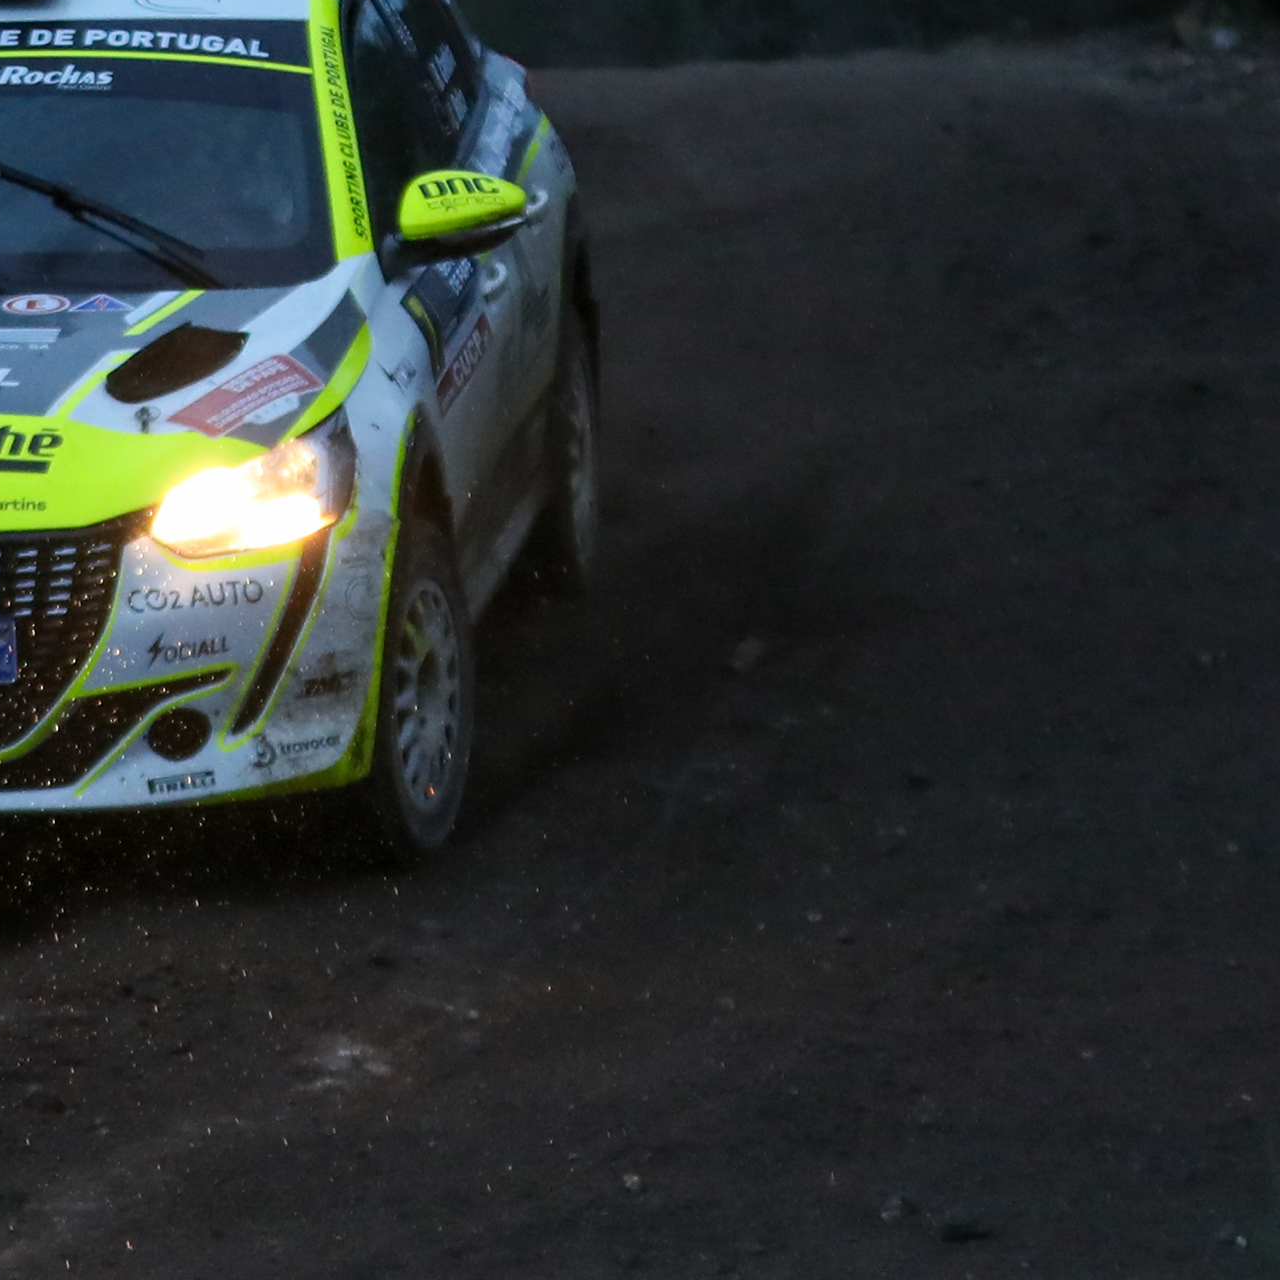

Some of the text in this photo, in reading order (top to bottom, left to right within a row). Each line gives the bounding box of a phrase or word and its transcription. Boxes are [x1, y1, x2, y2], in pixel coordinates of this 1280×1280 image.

[29, 29, 76, 46] DE
[83, 29, 270, 58] PORTUGAL
[321, 26, 369, 241] SPORTING CLUBE DE PORTUGAL
[191, 579, 264, 608] AUTO
